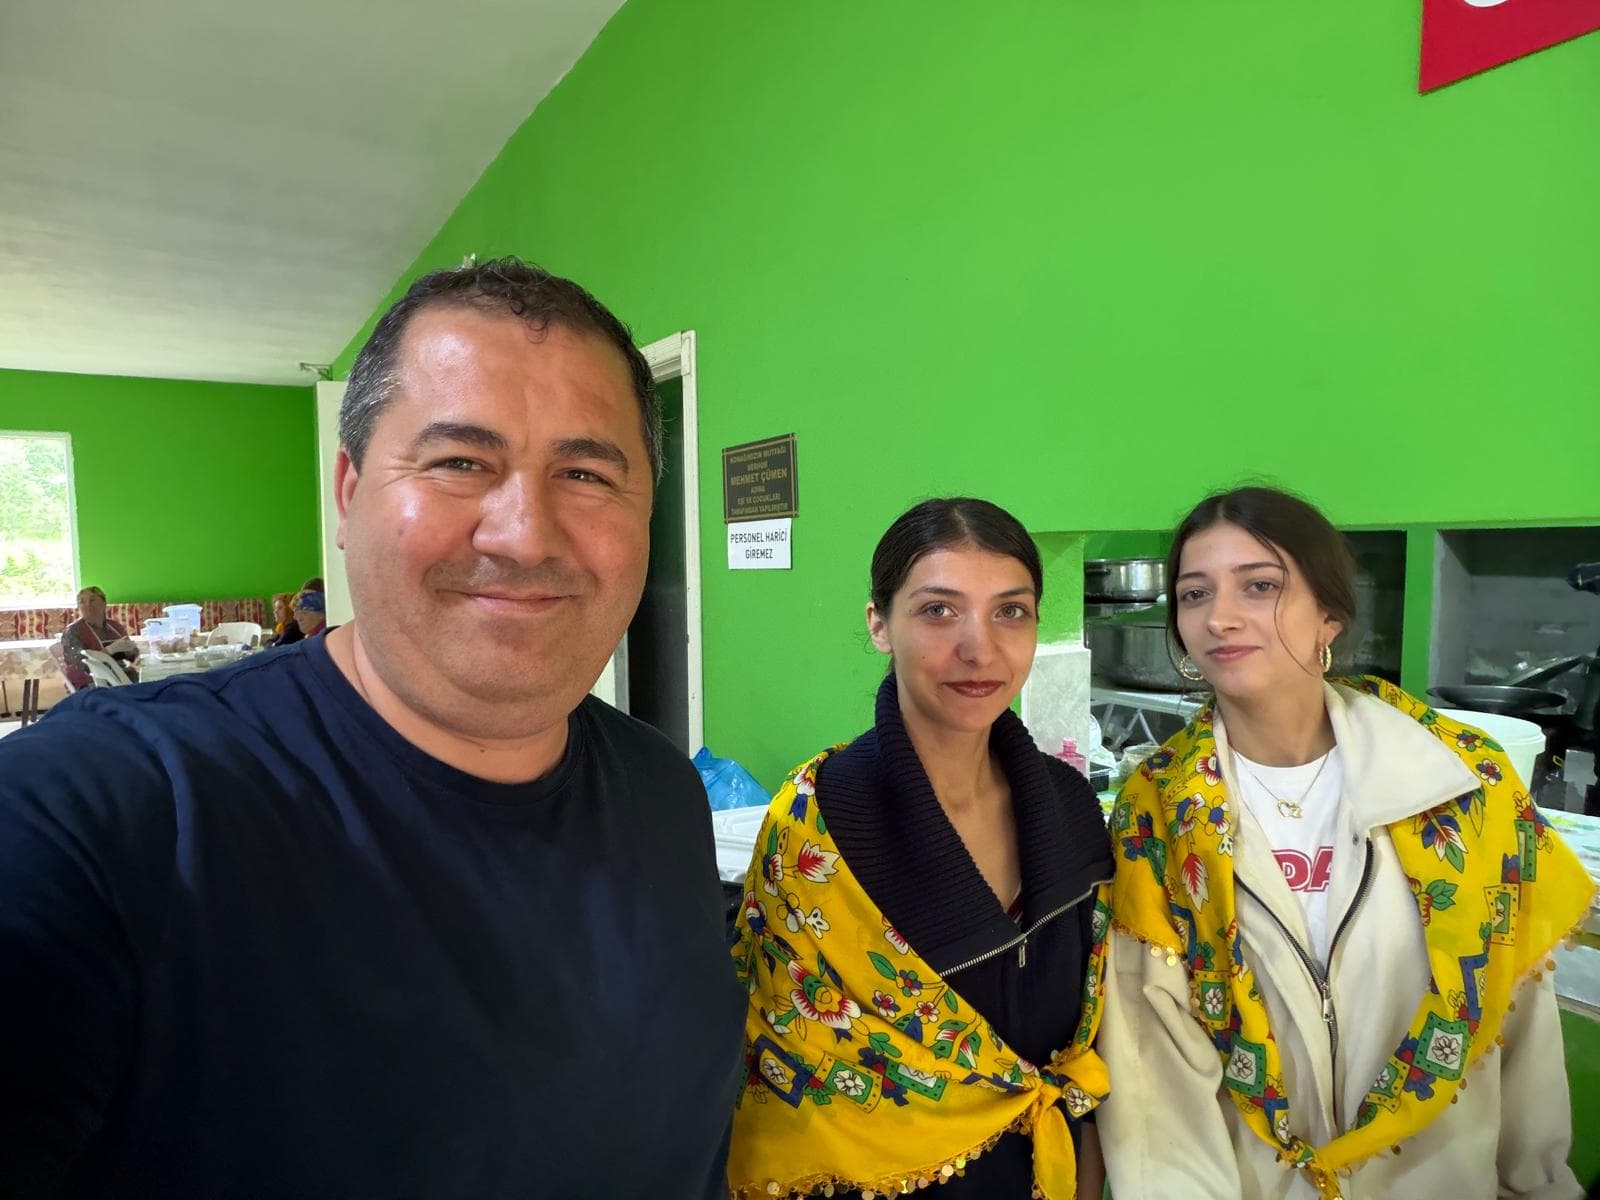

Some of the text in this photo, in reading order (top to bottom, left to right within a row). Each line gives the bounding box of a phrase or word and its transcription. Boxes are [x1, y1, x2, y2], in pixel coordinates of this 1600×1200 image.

[731, 468, 787, 486] MEHMET ÇÜMEN
[730, 528, 787, 544] PERSONEL HARİCİ
[745, 546, 773, 559] GİREMEZ
